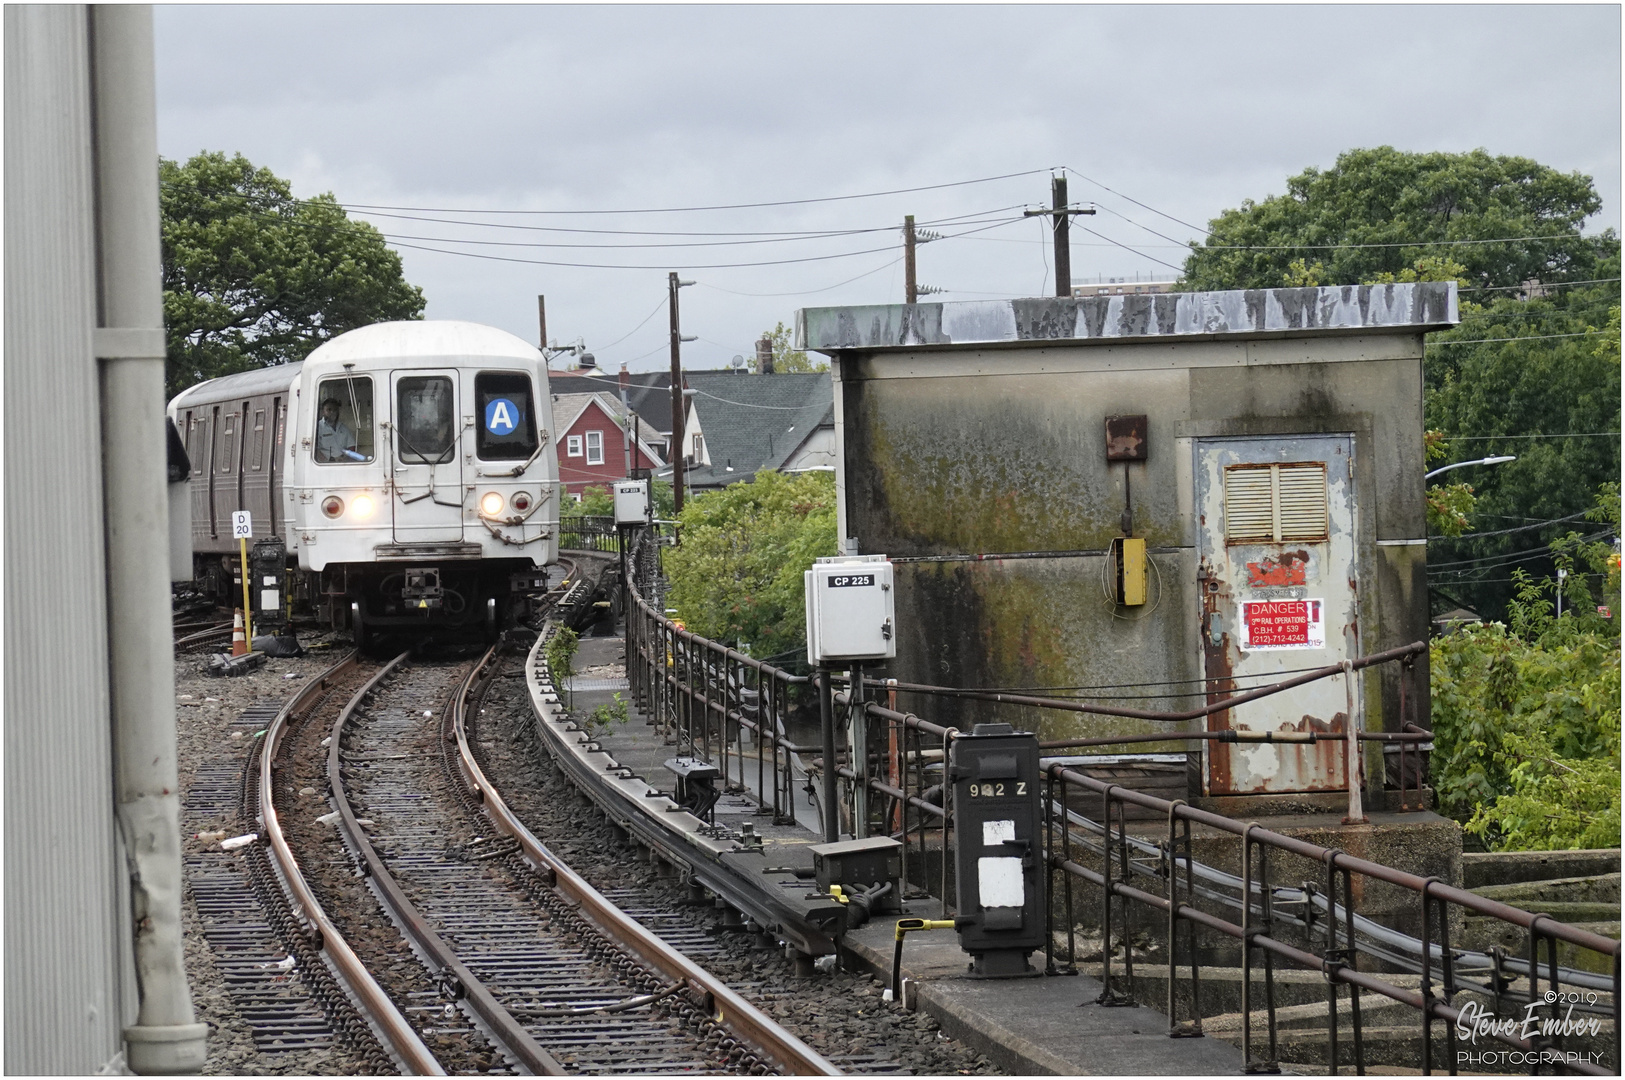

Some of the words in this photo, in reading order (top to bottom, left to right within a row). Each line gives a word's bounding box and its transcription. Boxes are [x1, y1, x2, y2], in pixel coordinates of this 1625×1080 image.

[490, 402, 513, 429] A
[238, 515, 246, 524] D
[236, 525, 249, 535] 20
[834, 577, 849, 586] CP
[852, 576, 870, 586] 225
[1251, 603, 1305, 615] DANGER
[1261, 617, 1274, 625] RAIL
[1274, 616, 1306, 624] OPERATIONS
[1286, 625, 1299, 633] 539
[1016, 781, 1027, 795] Z
